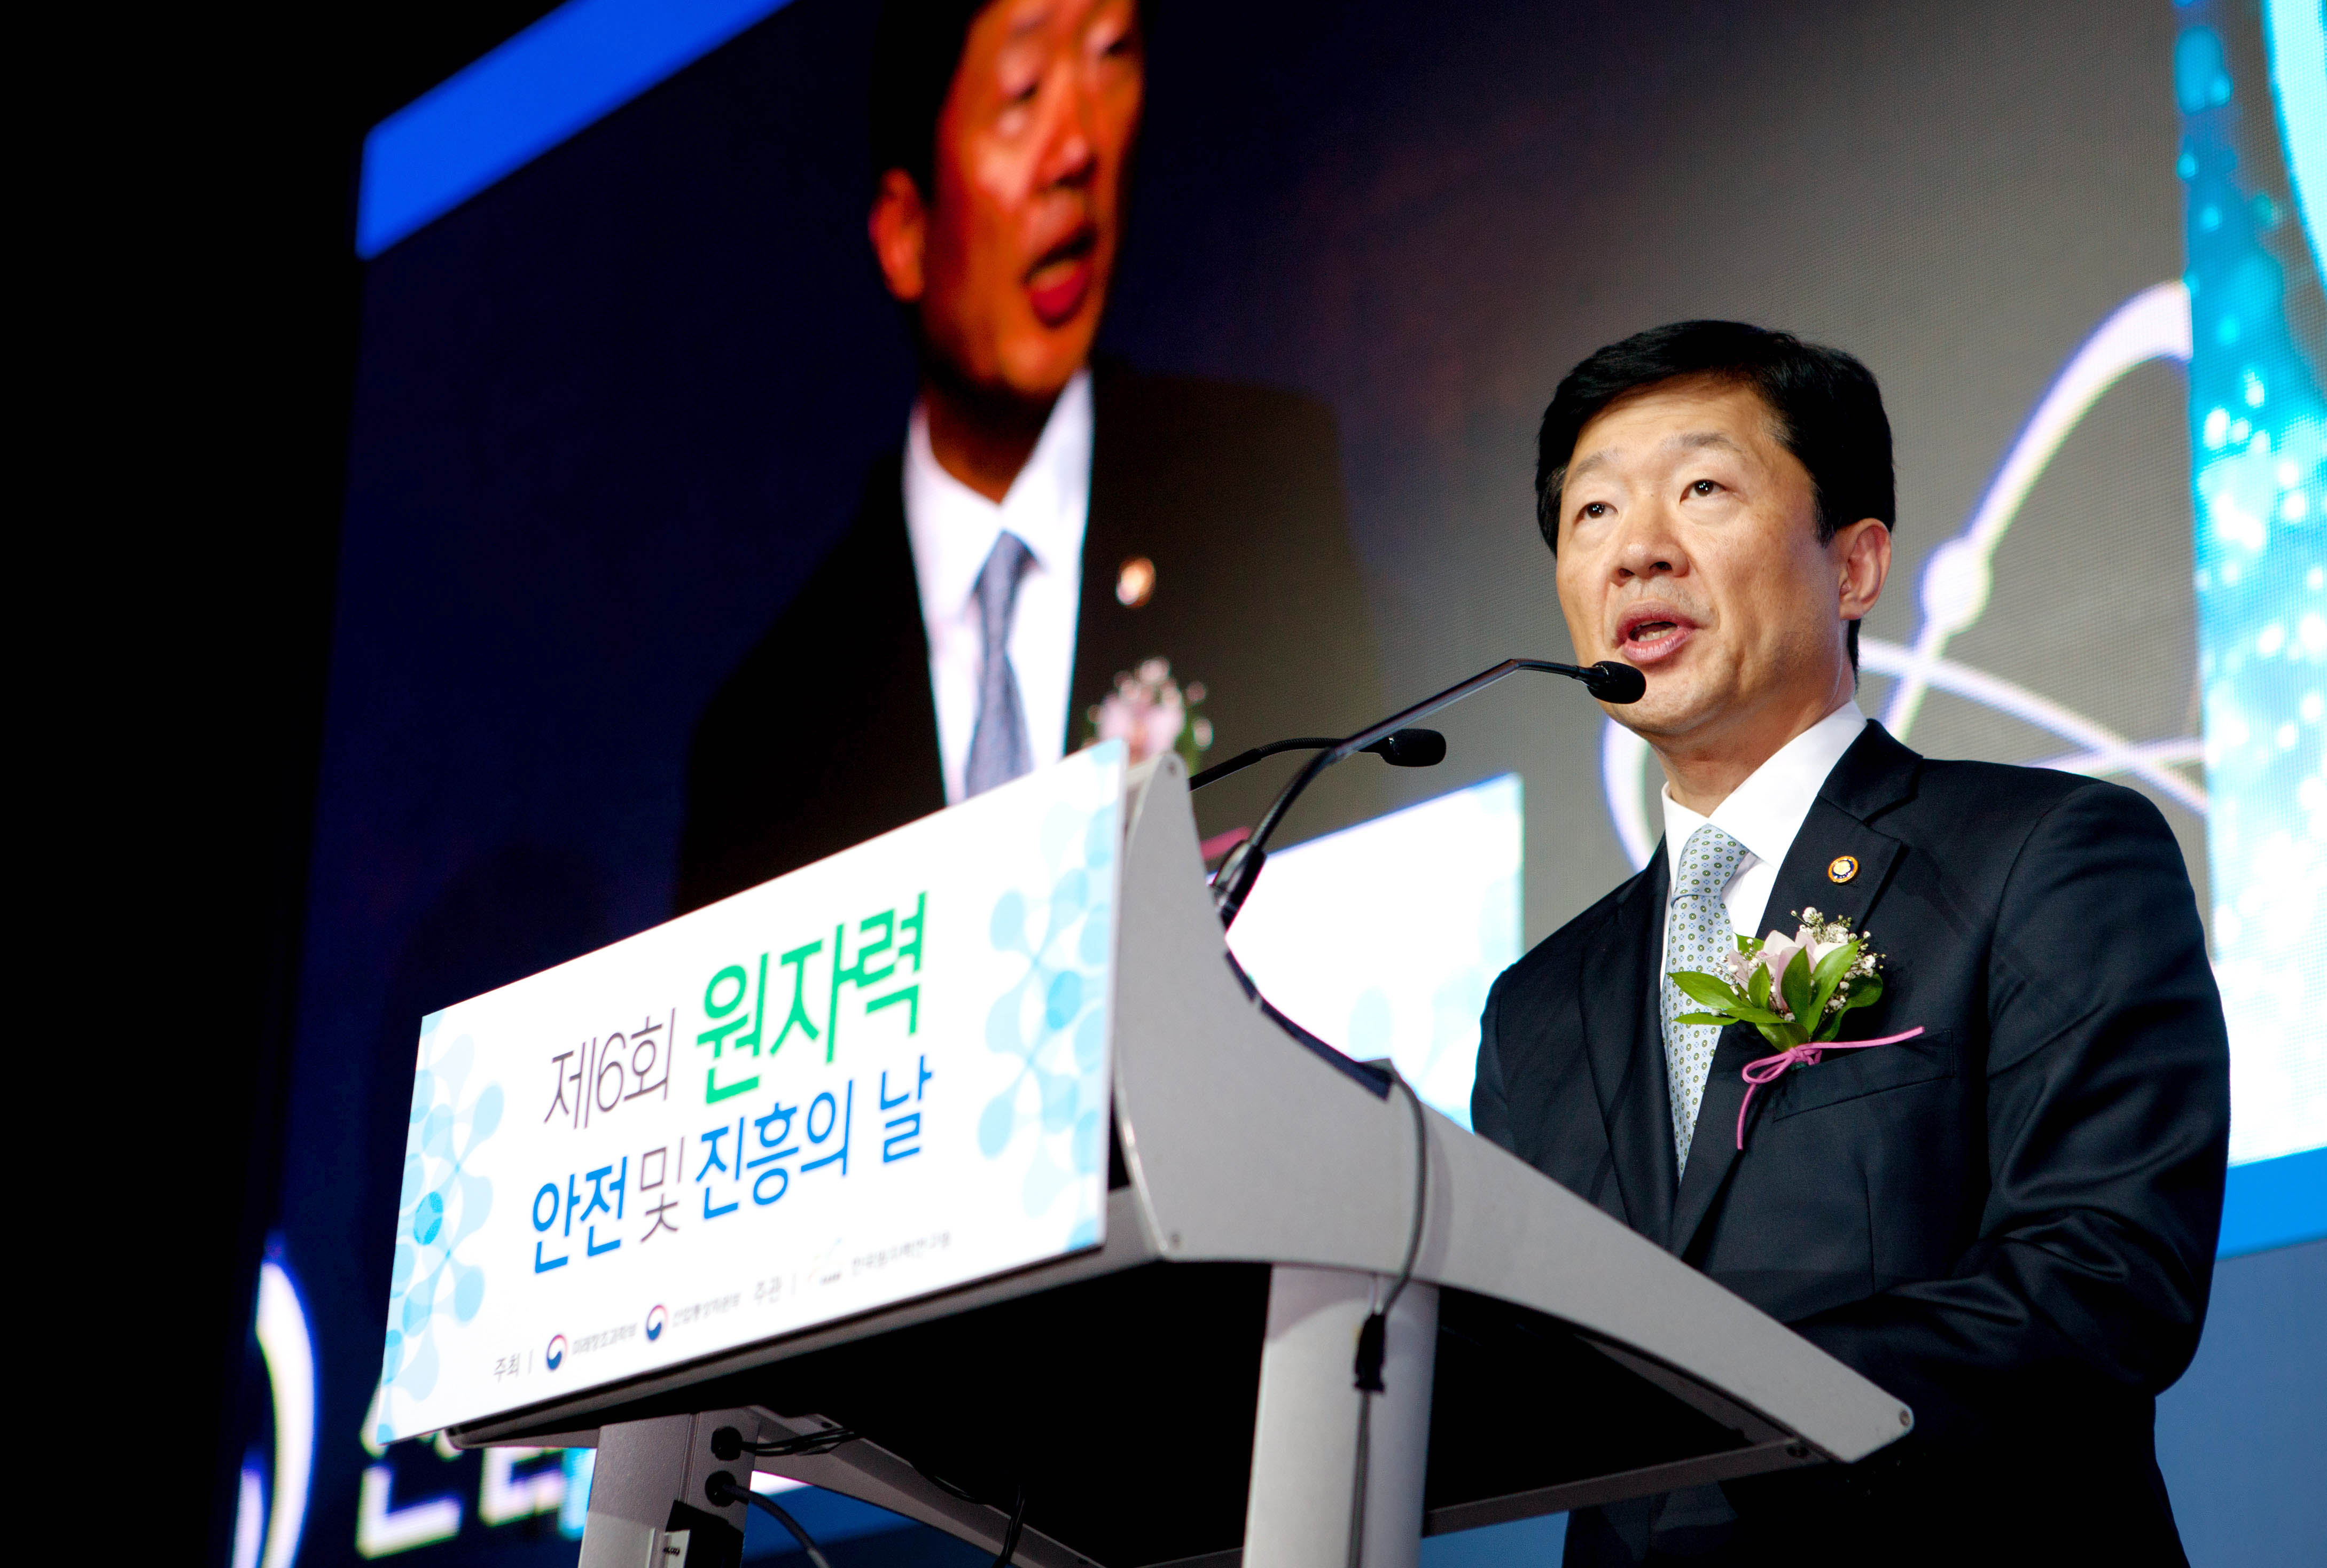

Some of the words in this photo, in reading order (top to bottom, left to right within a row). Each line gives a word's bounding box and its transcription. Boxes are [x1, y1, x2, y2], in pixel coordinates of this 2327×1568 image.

[543, 1006, 677, 1130] 제6회
[696, 890, 927, 1105] 원자력
[532, 1156, 628, 1274] 안전
[639, 1136, 685, 1243] 및
[695, 1079, 854, 1220] 진흥의
[879, 1054, 933, 1164] 날
[494, 1354, 520, 1382] 주최
[573, 1324, 637, 1354] 미래창조과학부
[755, 1277, 782, 1305] 주관
